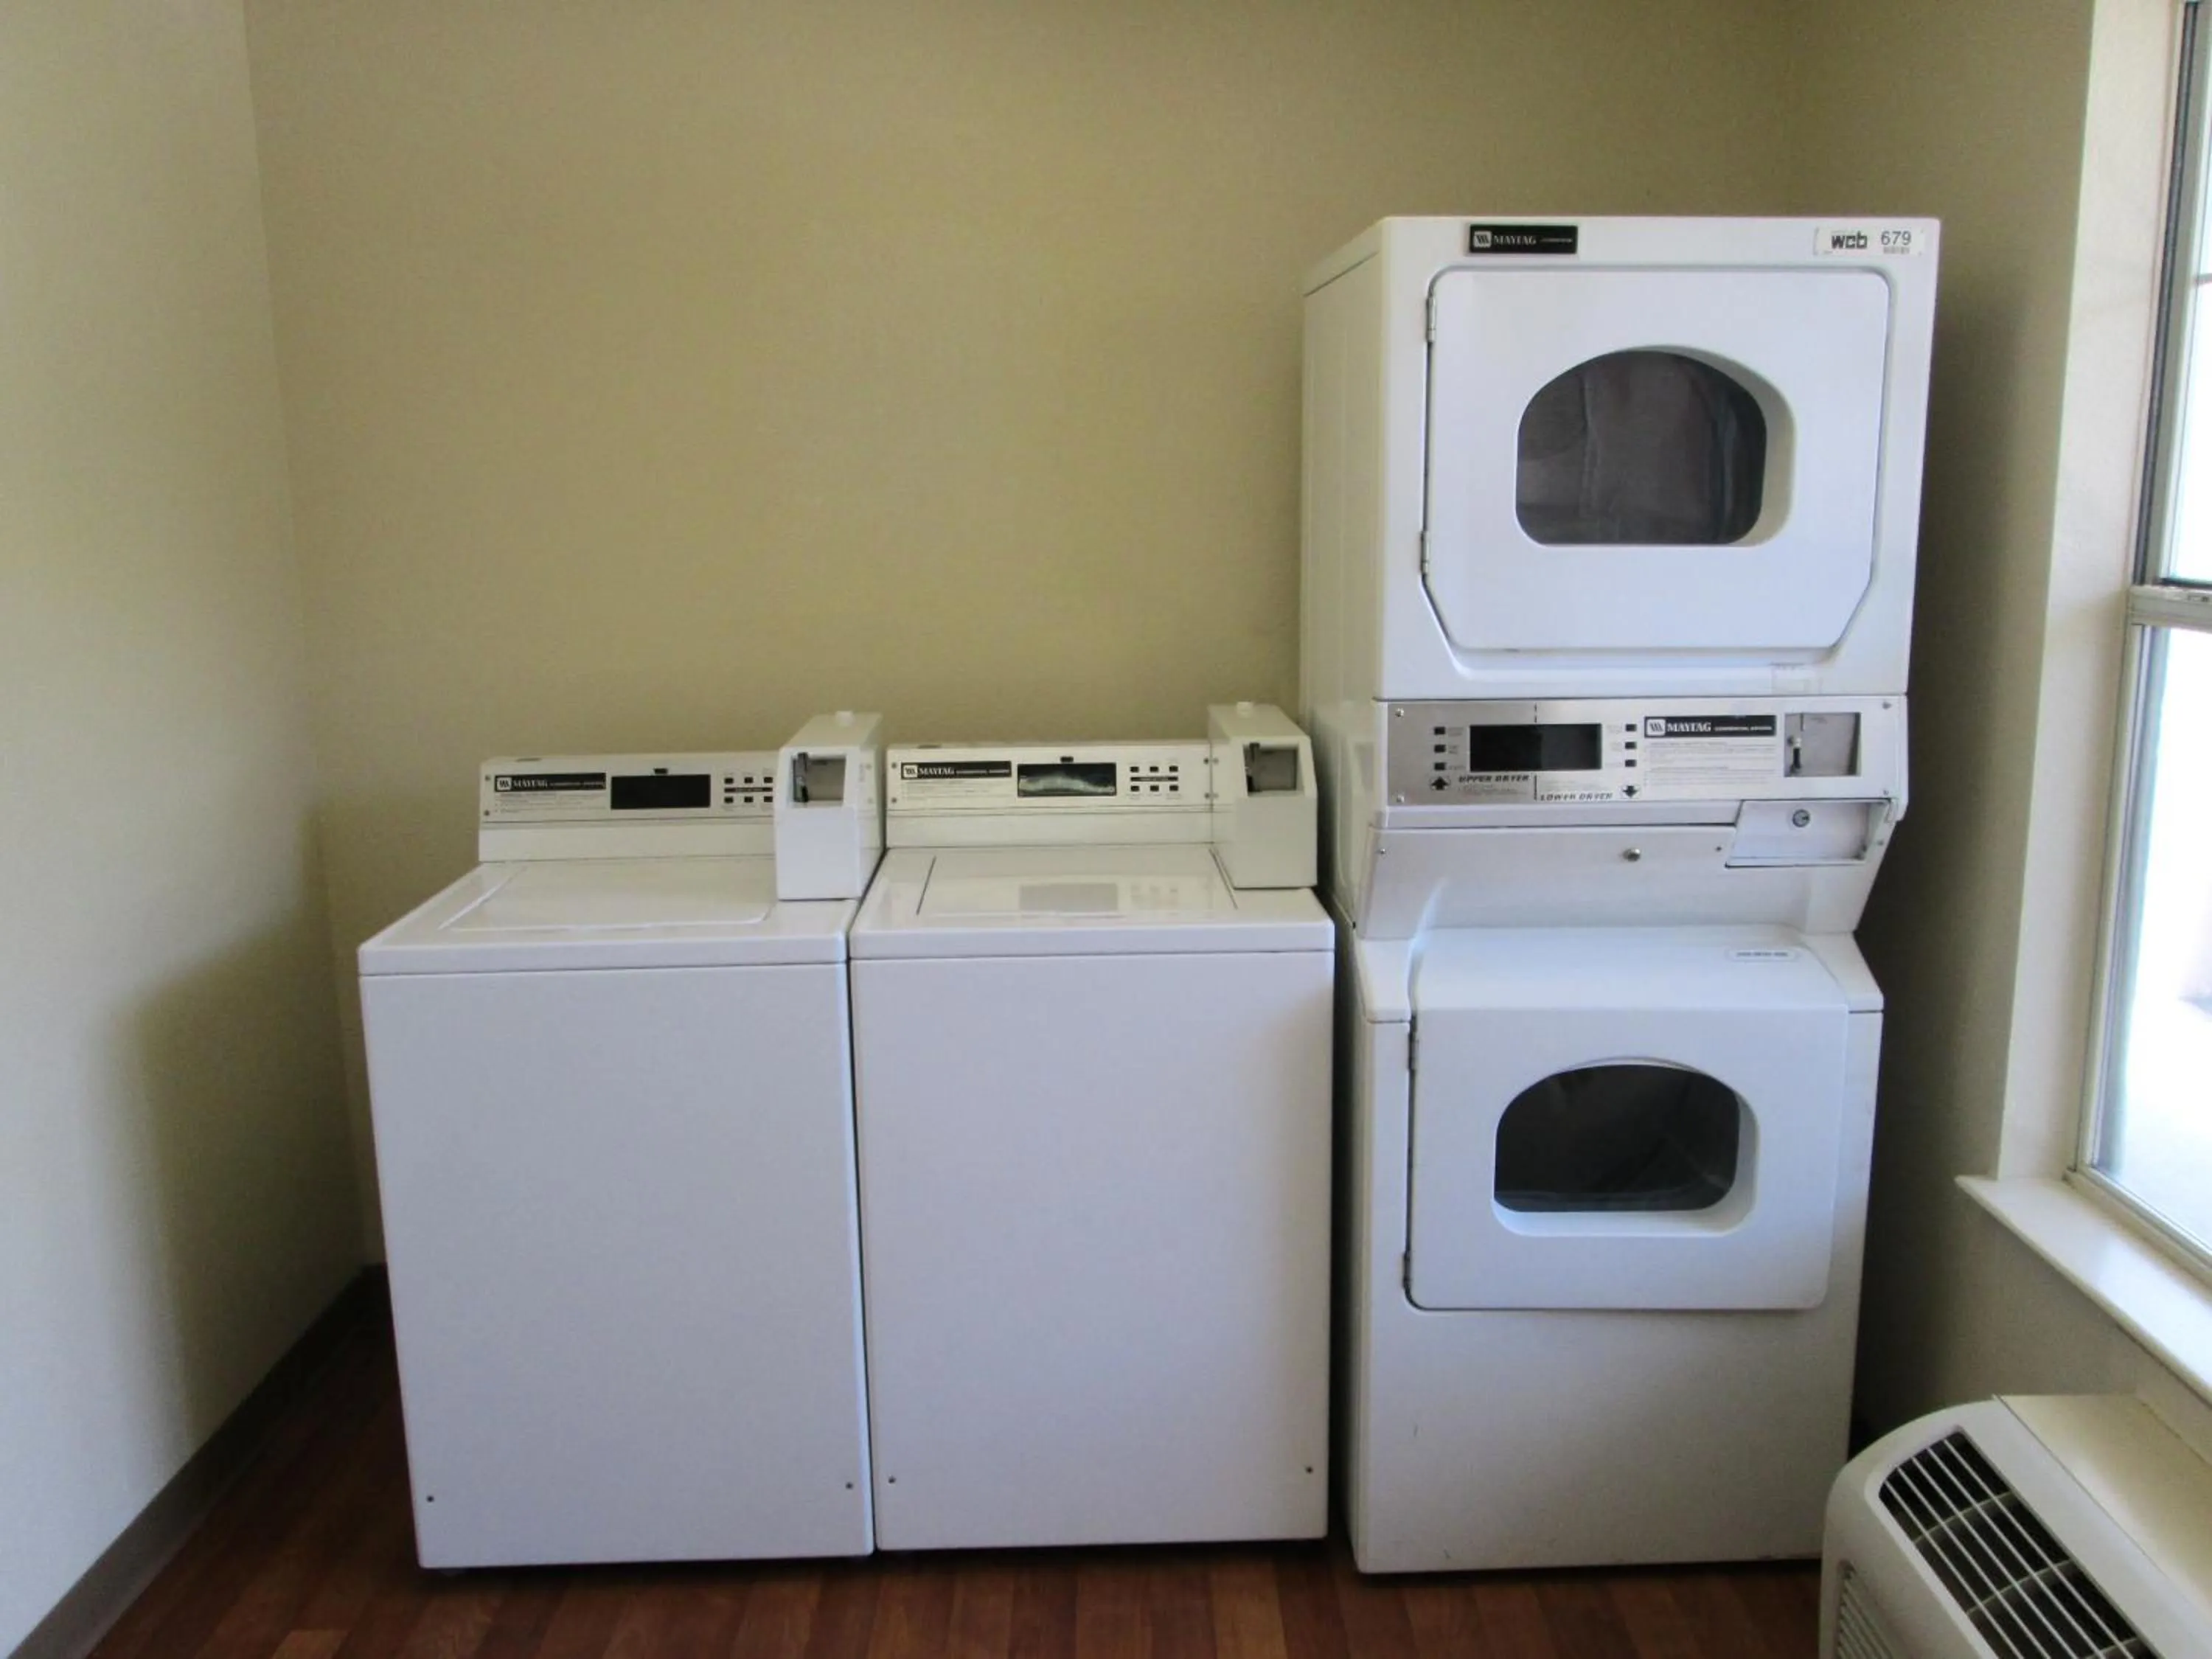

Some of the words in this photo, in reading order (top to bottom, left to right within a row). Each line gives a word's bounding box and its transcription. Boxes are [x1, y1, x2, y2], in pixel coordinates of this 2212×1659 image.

[1493, 235, 1537, 246] MAYTAG
[1831, 231, 1868, 249] wcb
[1881, 231, 1912, 246] 679
[1668, 722, 1711, 732] MAYTAG
[919, 767, 956, 776] MAYTAG
[1579, 793, 1613, 801] DRYER
